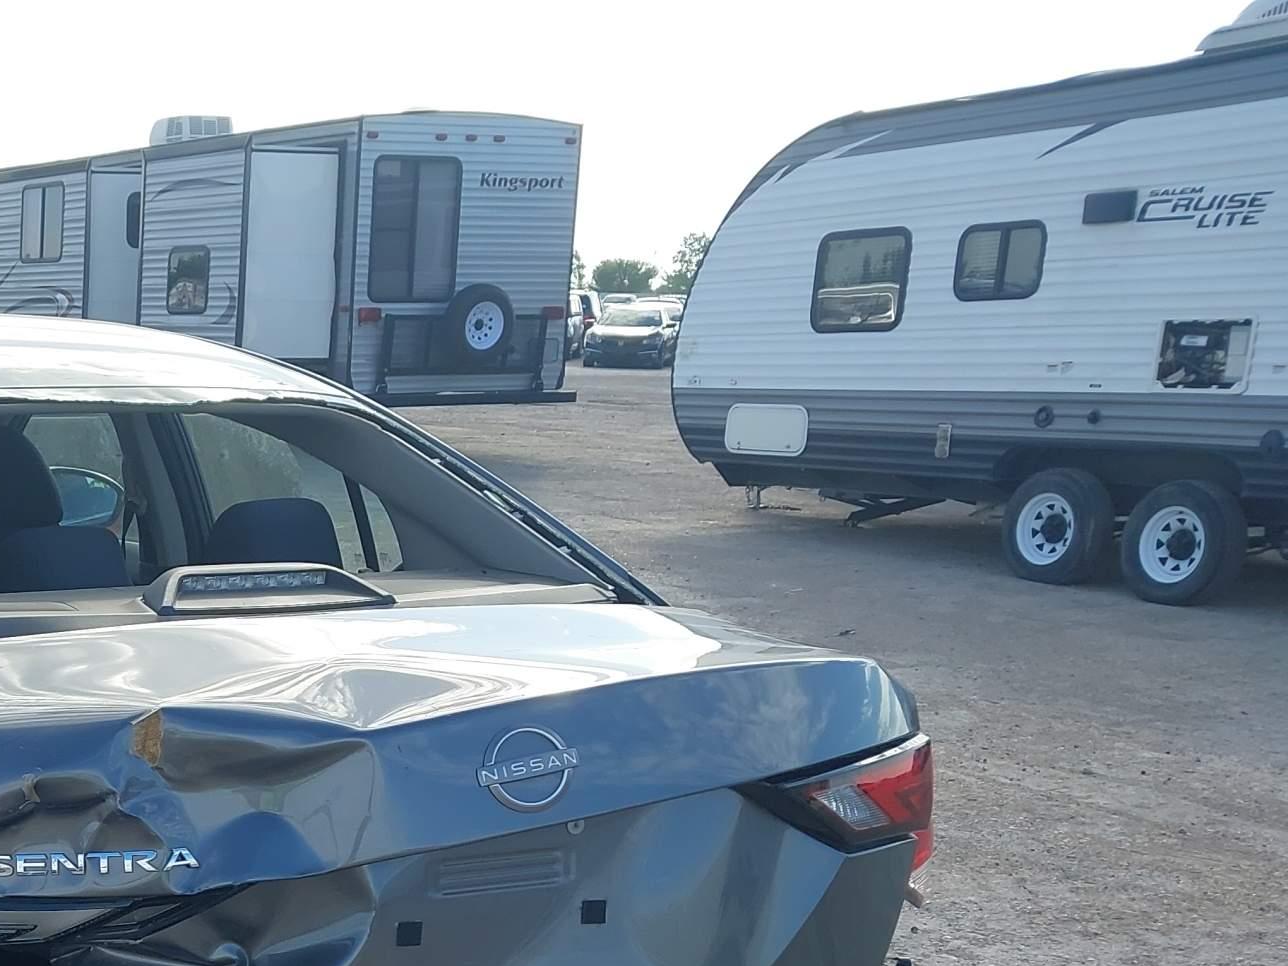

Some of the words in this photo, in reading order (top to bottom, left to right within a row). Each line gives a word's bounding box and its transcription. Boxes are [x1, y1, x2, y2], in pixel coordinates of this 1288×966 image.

[480, 172, 565, 192] Kingsport
[1149, 186, 1205, 197] SALEM
[1136, 191, 1276, 222] CRUISE
[1196, 209, 1266, 228] LITE
[481, 752, 577, 782] NISSAN
